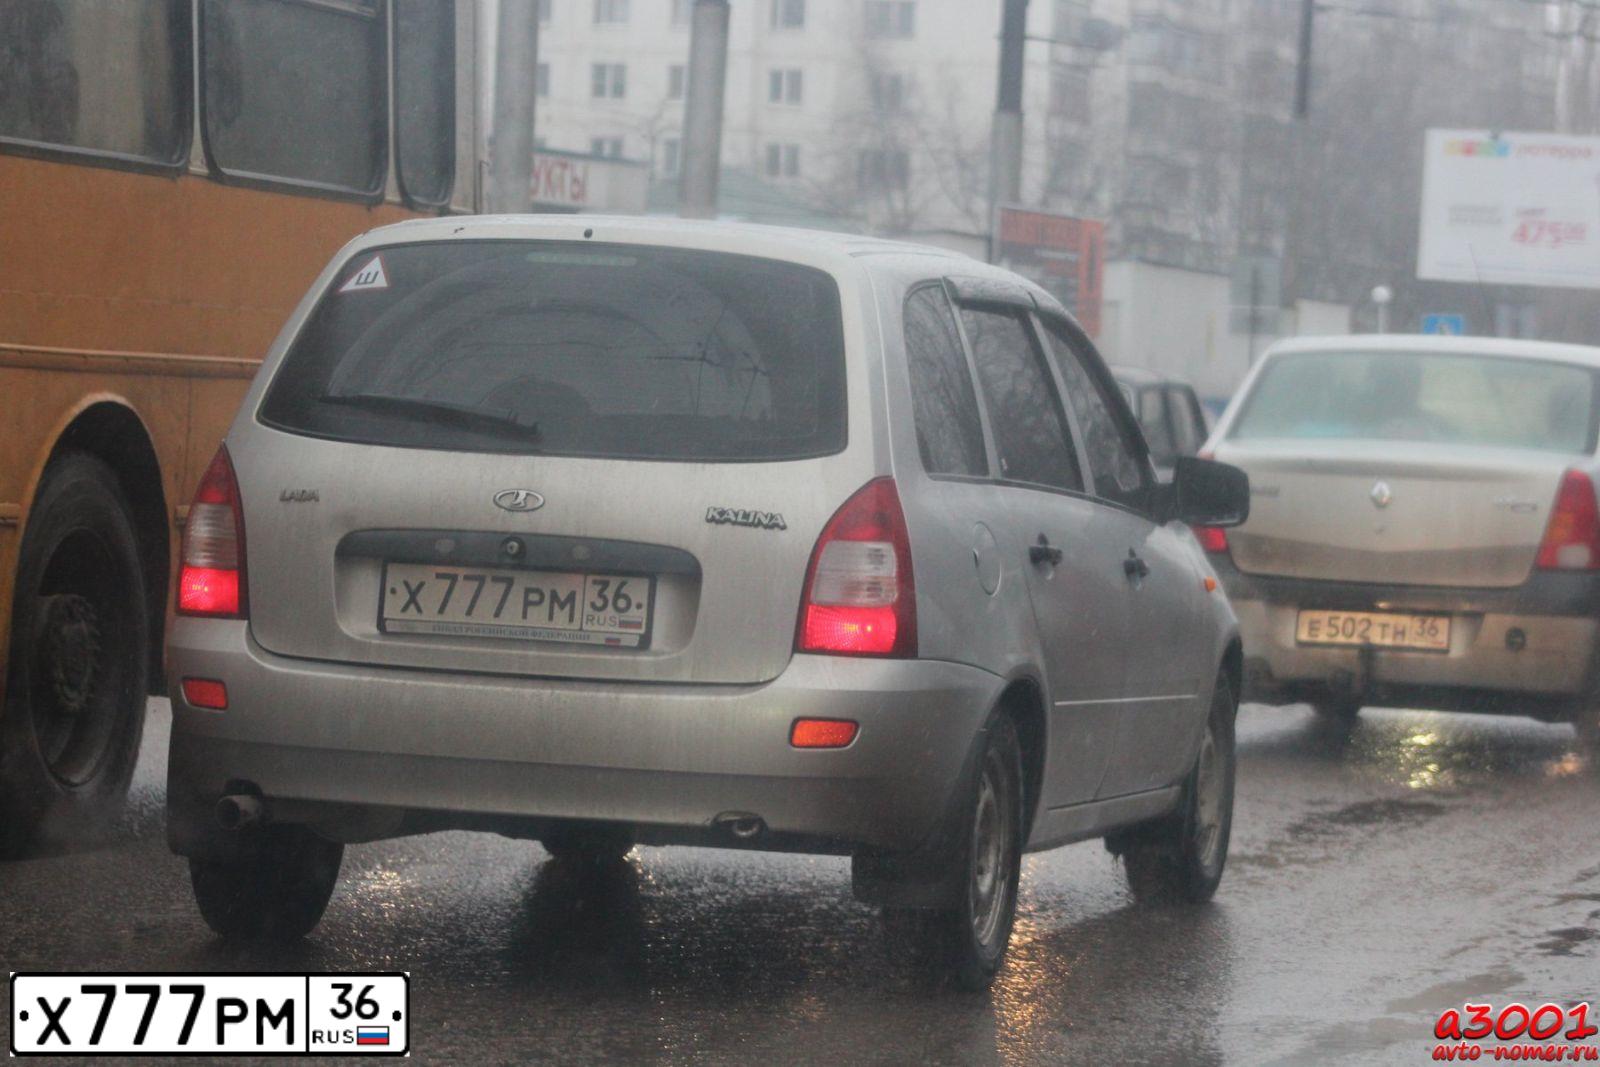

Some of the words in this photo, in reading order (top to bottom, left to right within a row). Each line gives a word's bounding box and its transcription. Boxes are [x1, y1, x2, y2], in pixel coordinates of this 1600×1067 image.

[354, 270, 380, 286] Ш
[279, 488, 320, 503] LADA
[705, 506, 788, 531] KALINA
[589, 578, 633, 614] 36
[585, 614, 619, 627] RUS
[1415, 617, 1440, 637] 36
